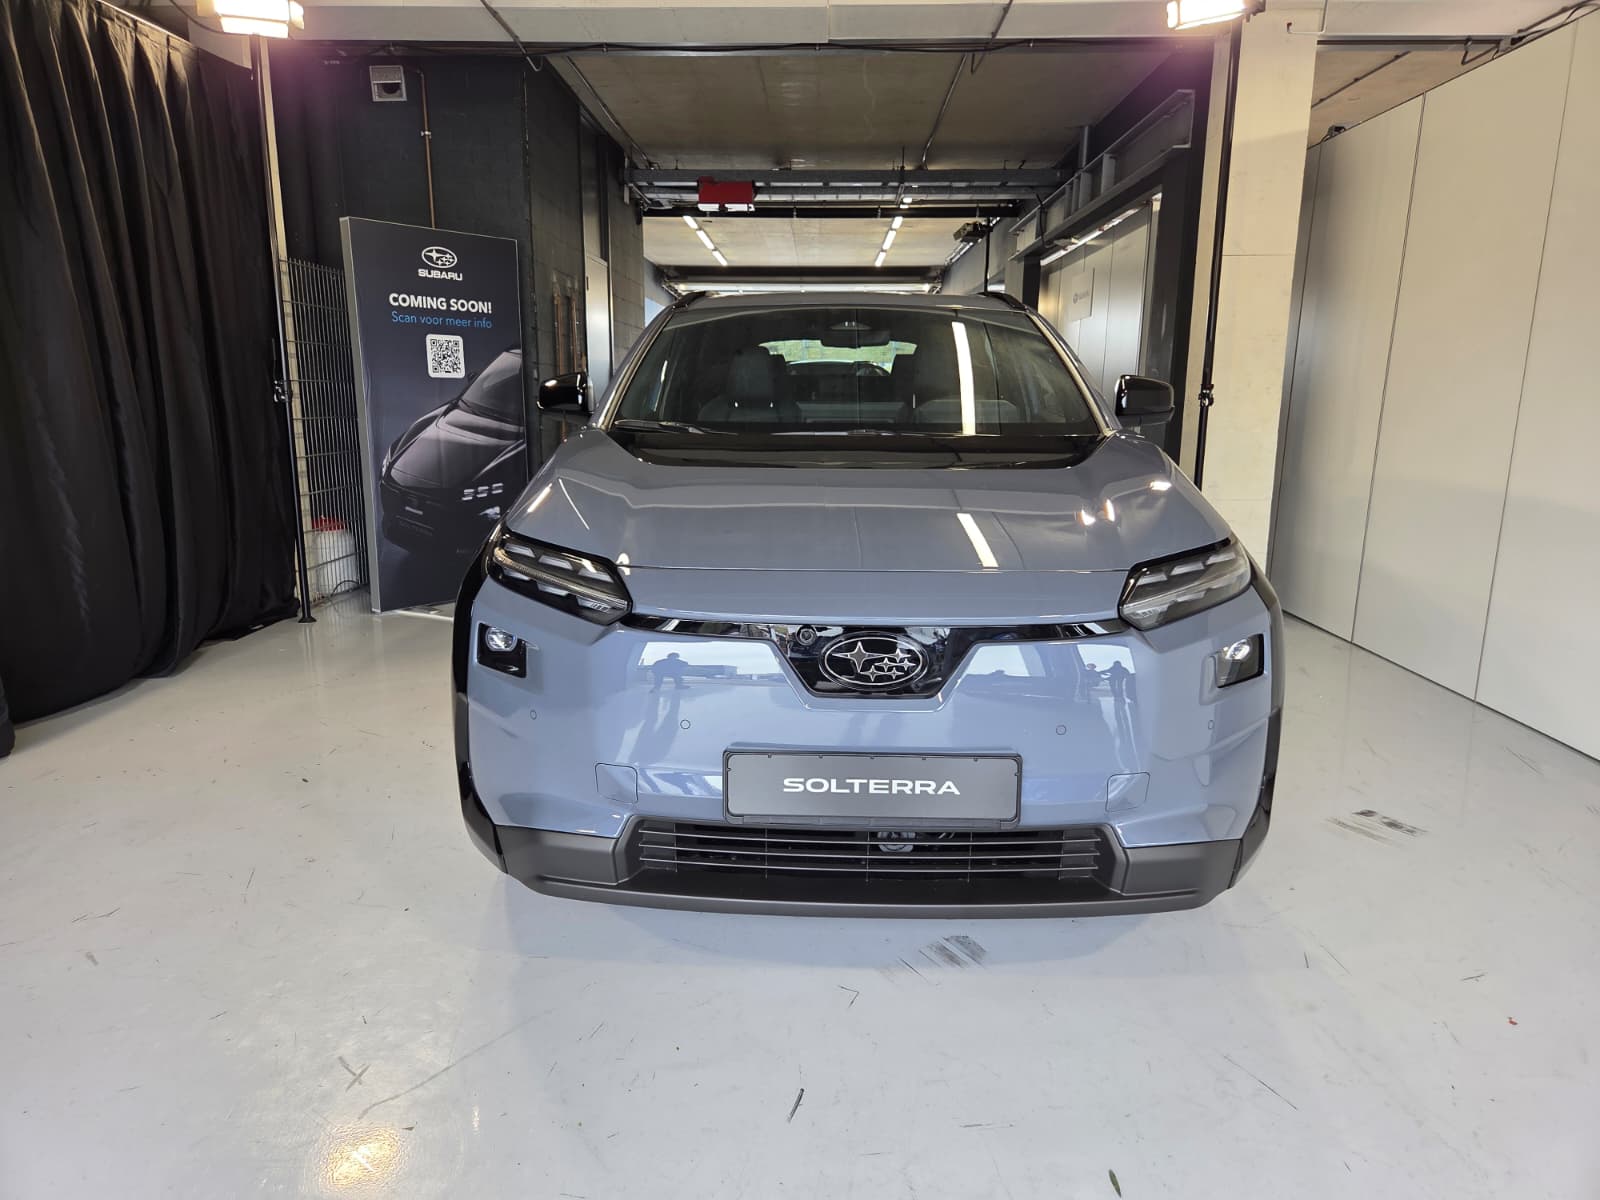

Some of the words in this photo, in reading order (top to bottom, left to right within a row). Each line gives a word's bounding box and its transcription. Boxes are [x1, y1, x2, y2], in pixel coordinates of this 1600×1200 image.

[418, 268, 463, 281] SUBARU
[389, 293, 447, 310] COMING
[450, 299, 492, 314] SOON!
[391, 311, 417, 323] Scan
[420, 316, 443, 325] voor
[446, 318, 472, 327] meer
[474, 318, 492, 328] info
[783, 777, 961, 796] SOLTERRA
